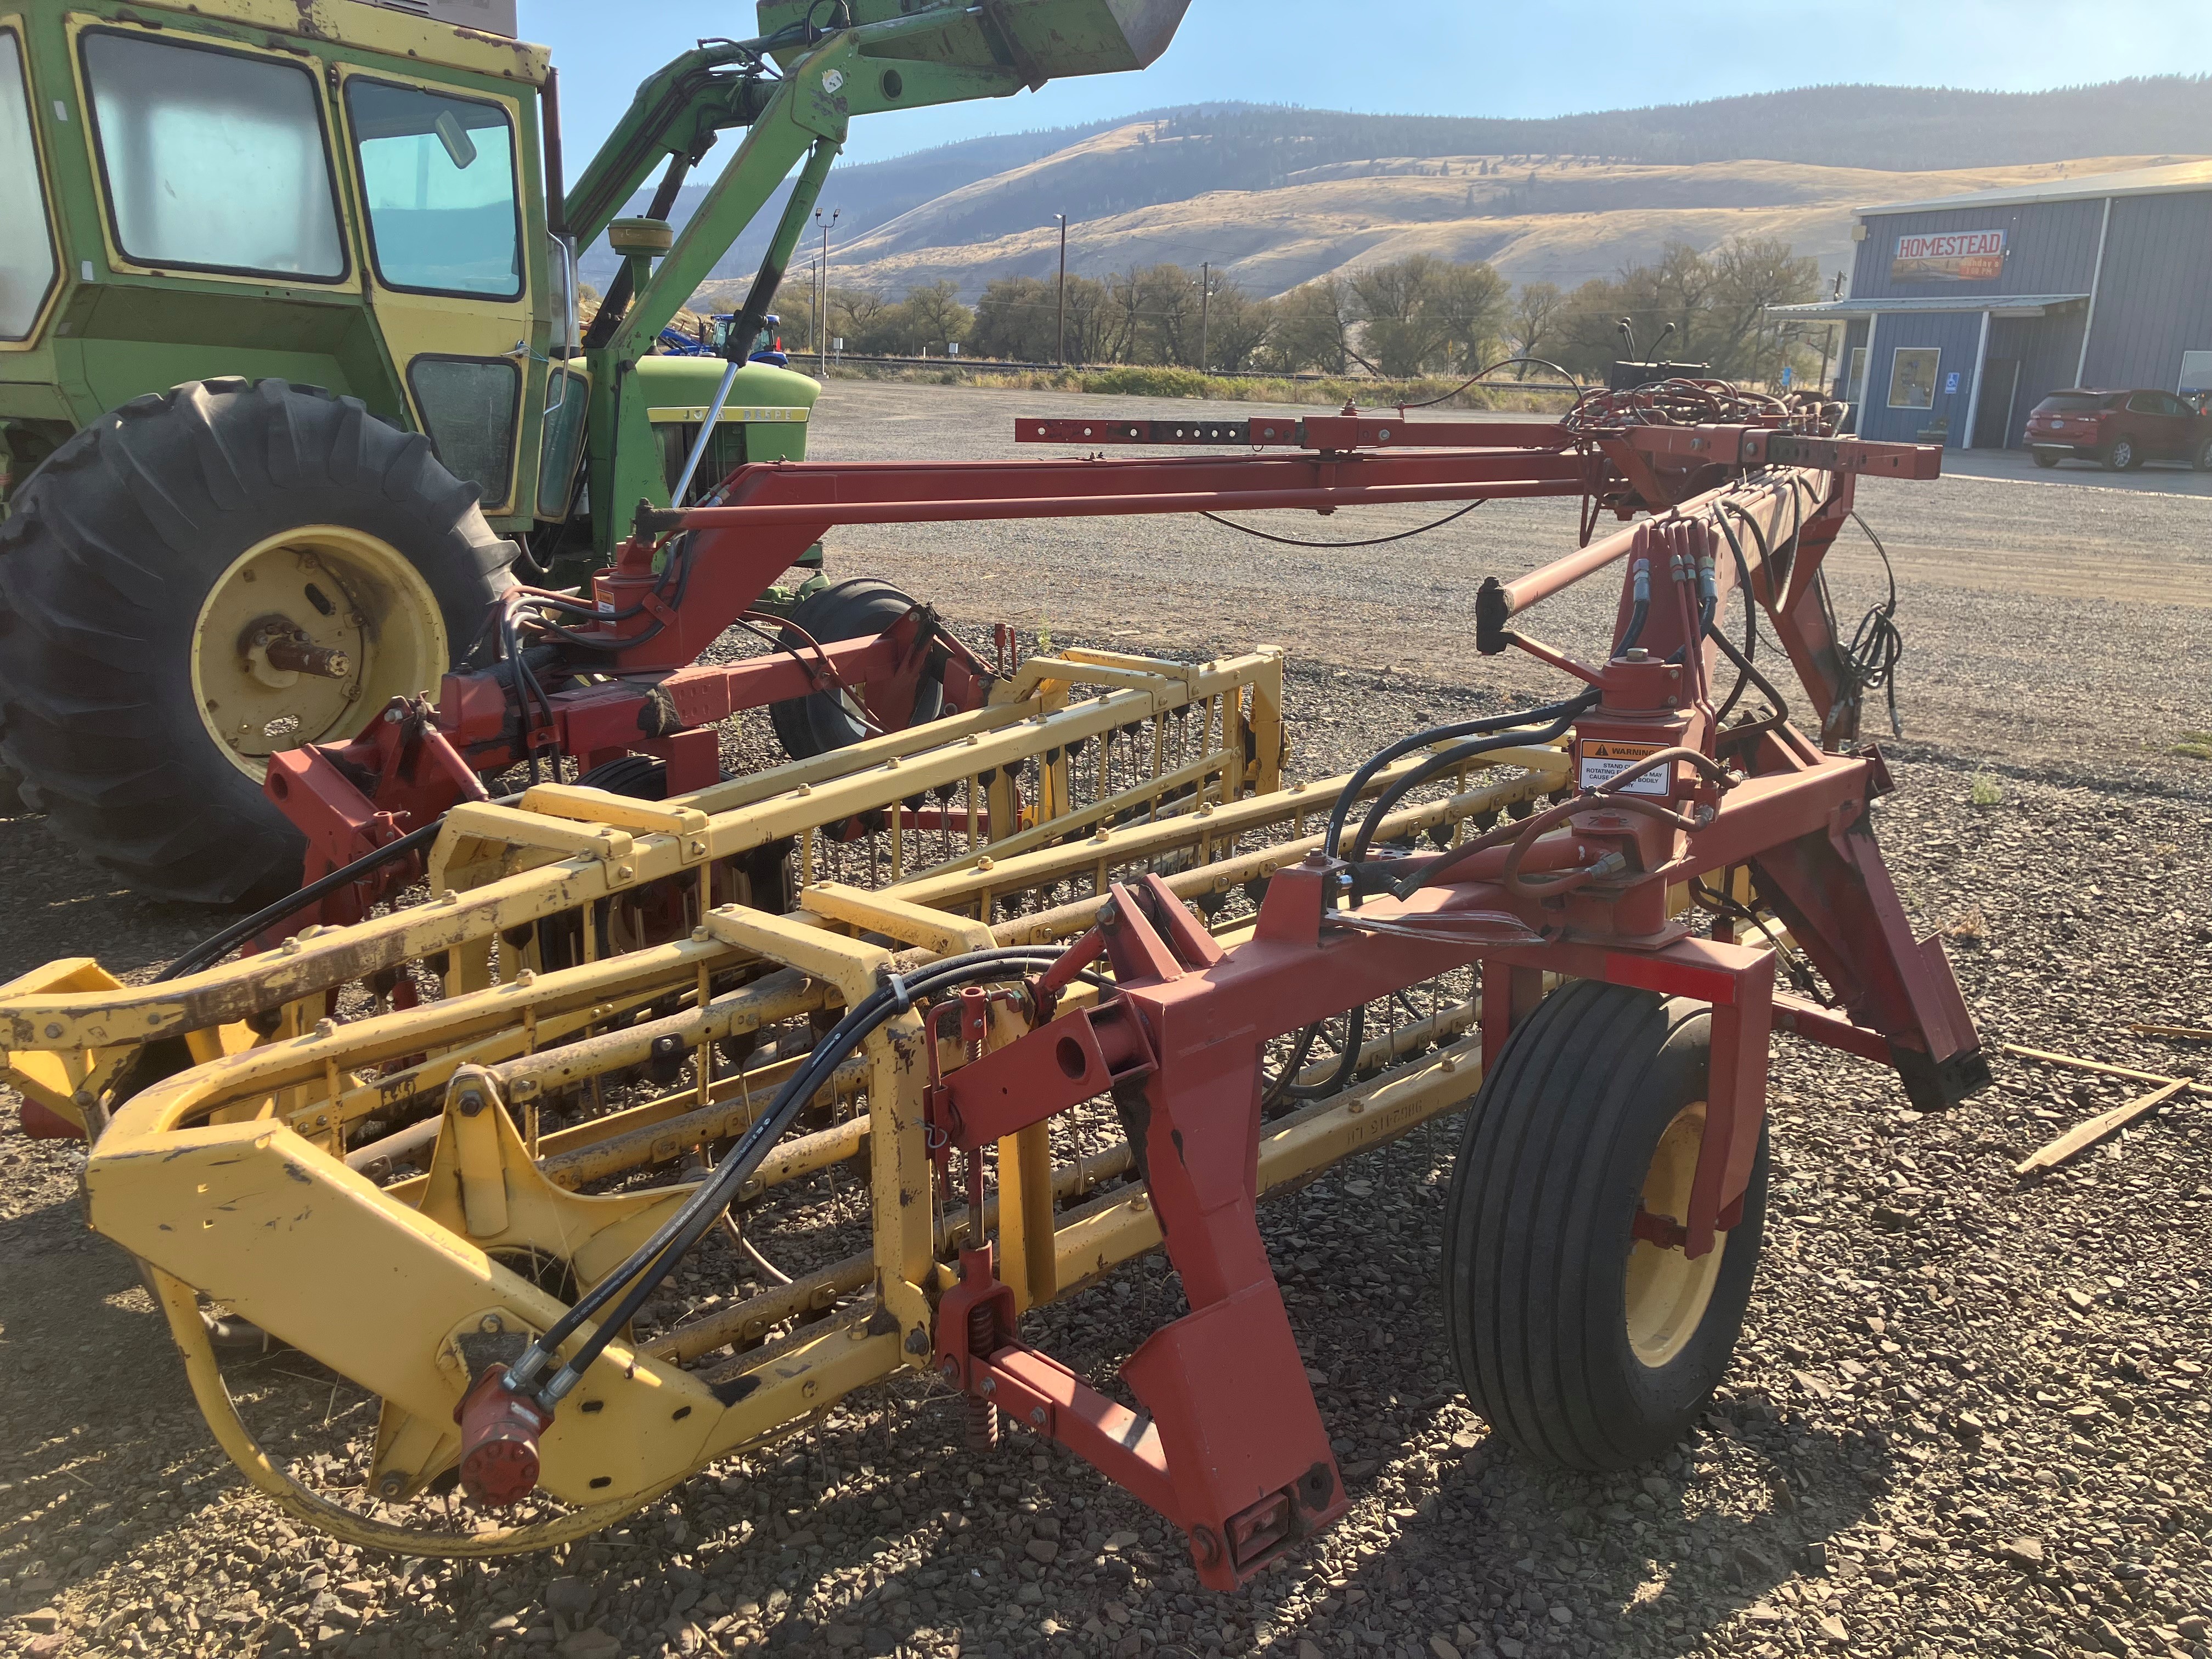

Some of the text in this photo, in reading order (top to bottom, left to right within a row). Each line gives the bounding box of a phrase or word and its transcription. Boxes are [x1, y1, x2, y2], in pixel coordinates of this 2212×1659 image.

[1899, 234, 2001, 257] HOMESTEAD
[684, 409, 792, 420] JON DEERE
[1612, 748, 1655, 756] WARNING
